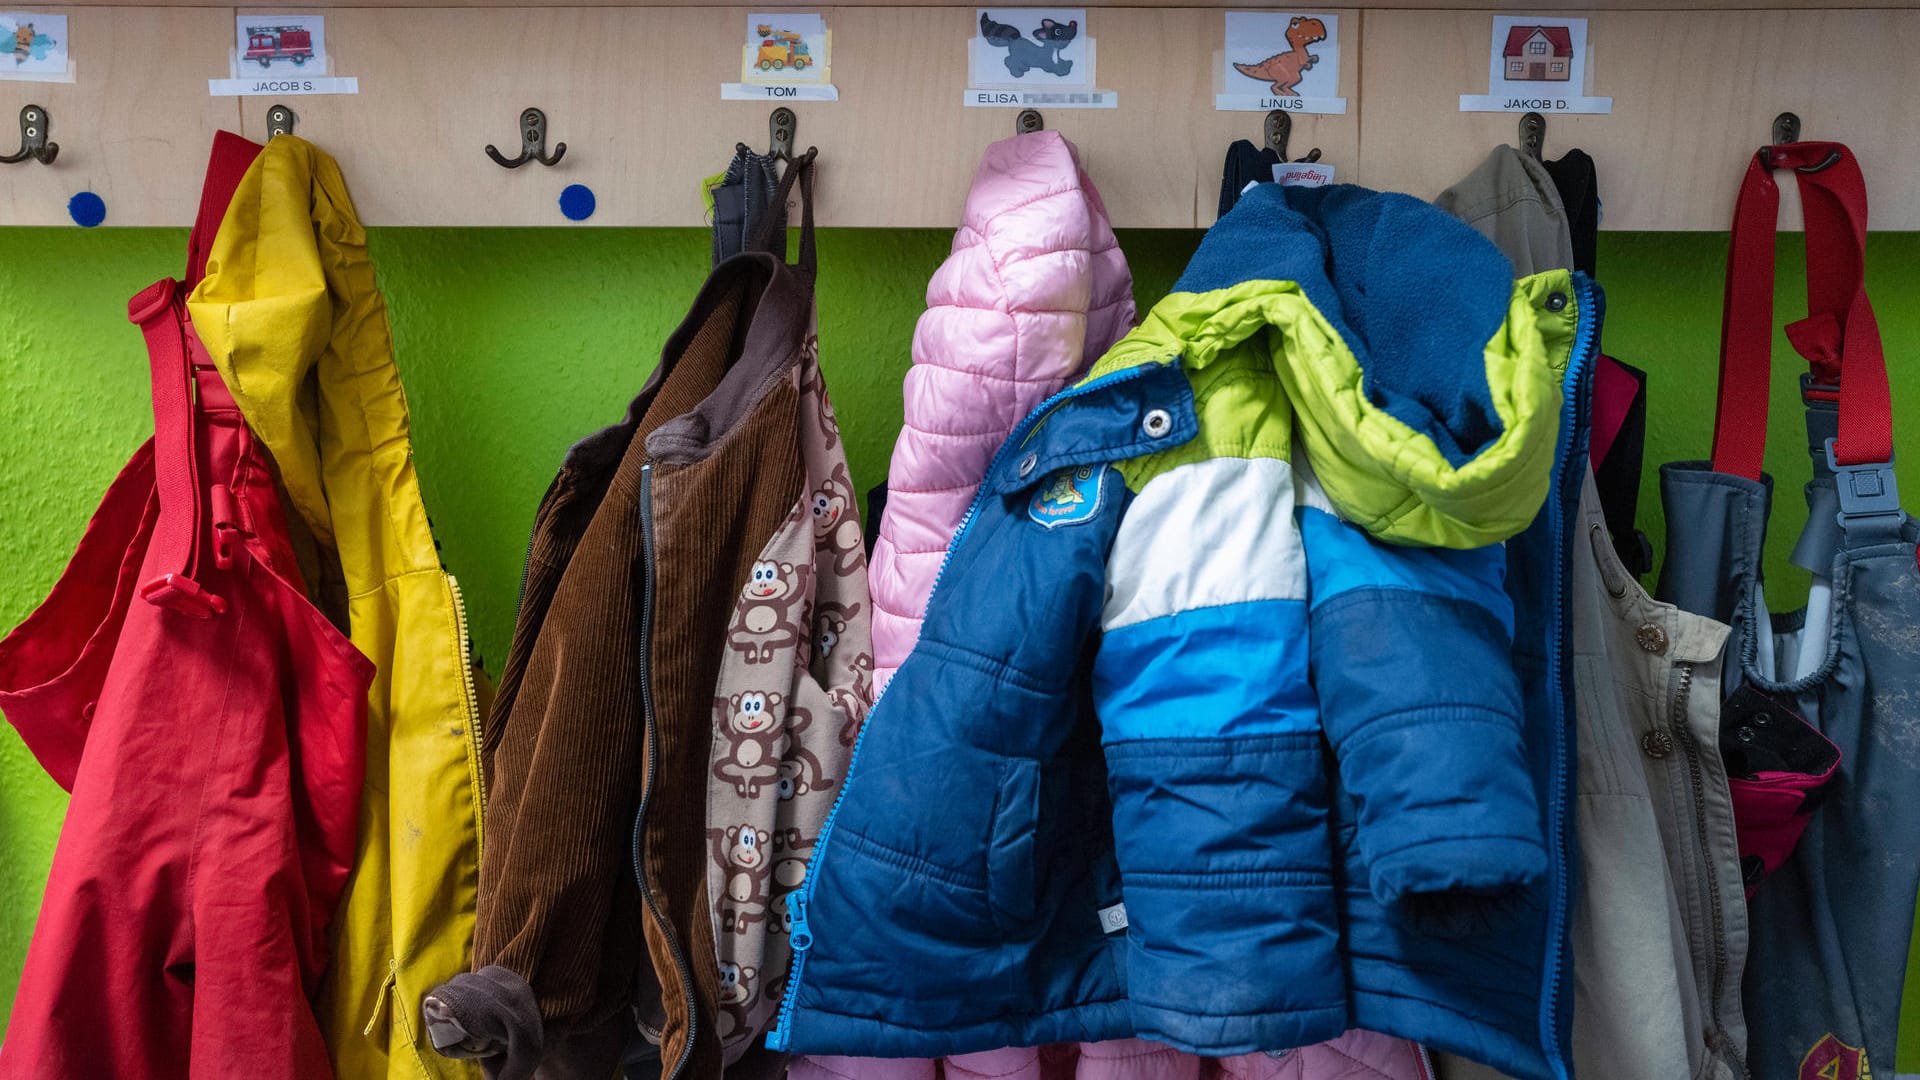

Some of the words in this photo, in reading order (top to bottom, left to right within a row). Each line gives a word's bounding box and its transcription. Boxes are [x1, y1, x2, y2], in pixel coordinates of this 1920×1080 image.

[252, 81, 300, 92] JACOB
[303, 81, 316, 91] S.
[765, 87, 797, 97] TOM
[978, 93, 1019, 103] ELISA
[1260, 98, 1303, 109] LINUS
[1504, 99, 1552, 109] JAKOB
[1556, 99, 1569, 110] D.
